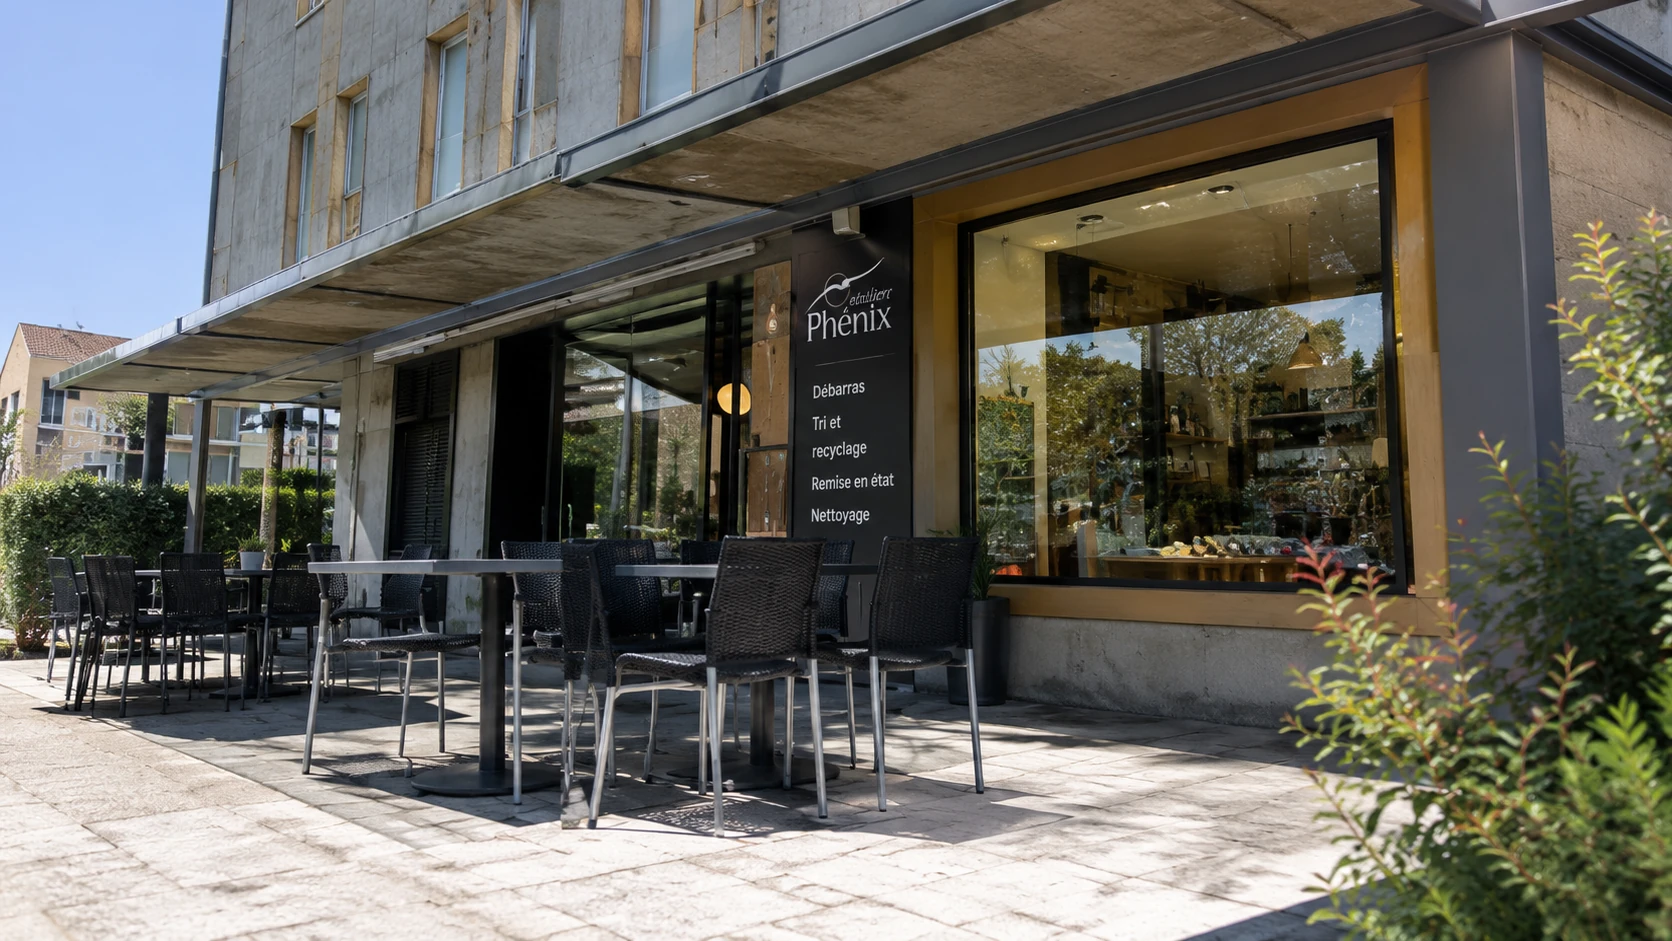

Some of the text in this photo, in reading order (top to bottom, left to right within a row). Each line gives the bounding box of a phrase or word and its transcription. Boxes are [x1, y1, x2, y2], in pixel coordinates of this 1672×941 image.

[807, 303, 892, 342] Phénix
[812, 381, 866, 399] Débarras
[812, 415, 842, 431] Tri et
[812, 441, 868, 460] recyclage
[811, 472, 895, 491] Remise en état
[811, 508, 870, 525] Nettoyage
